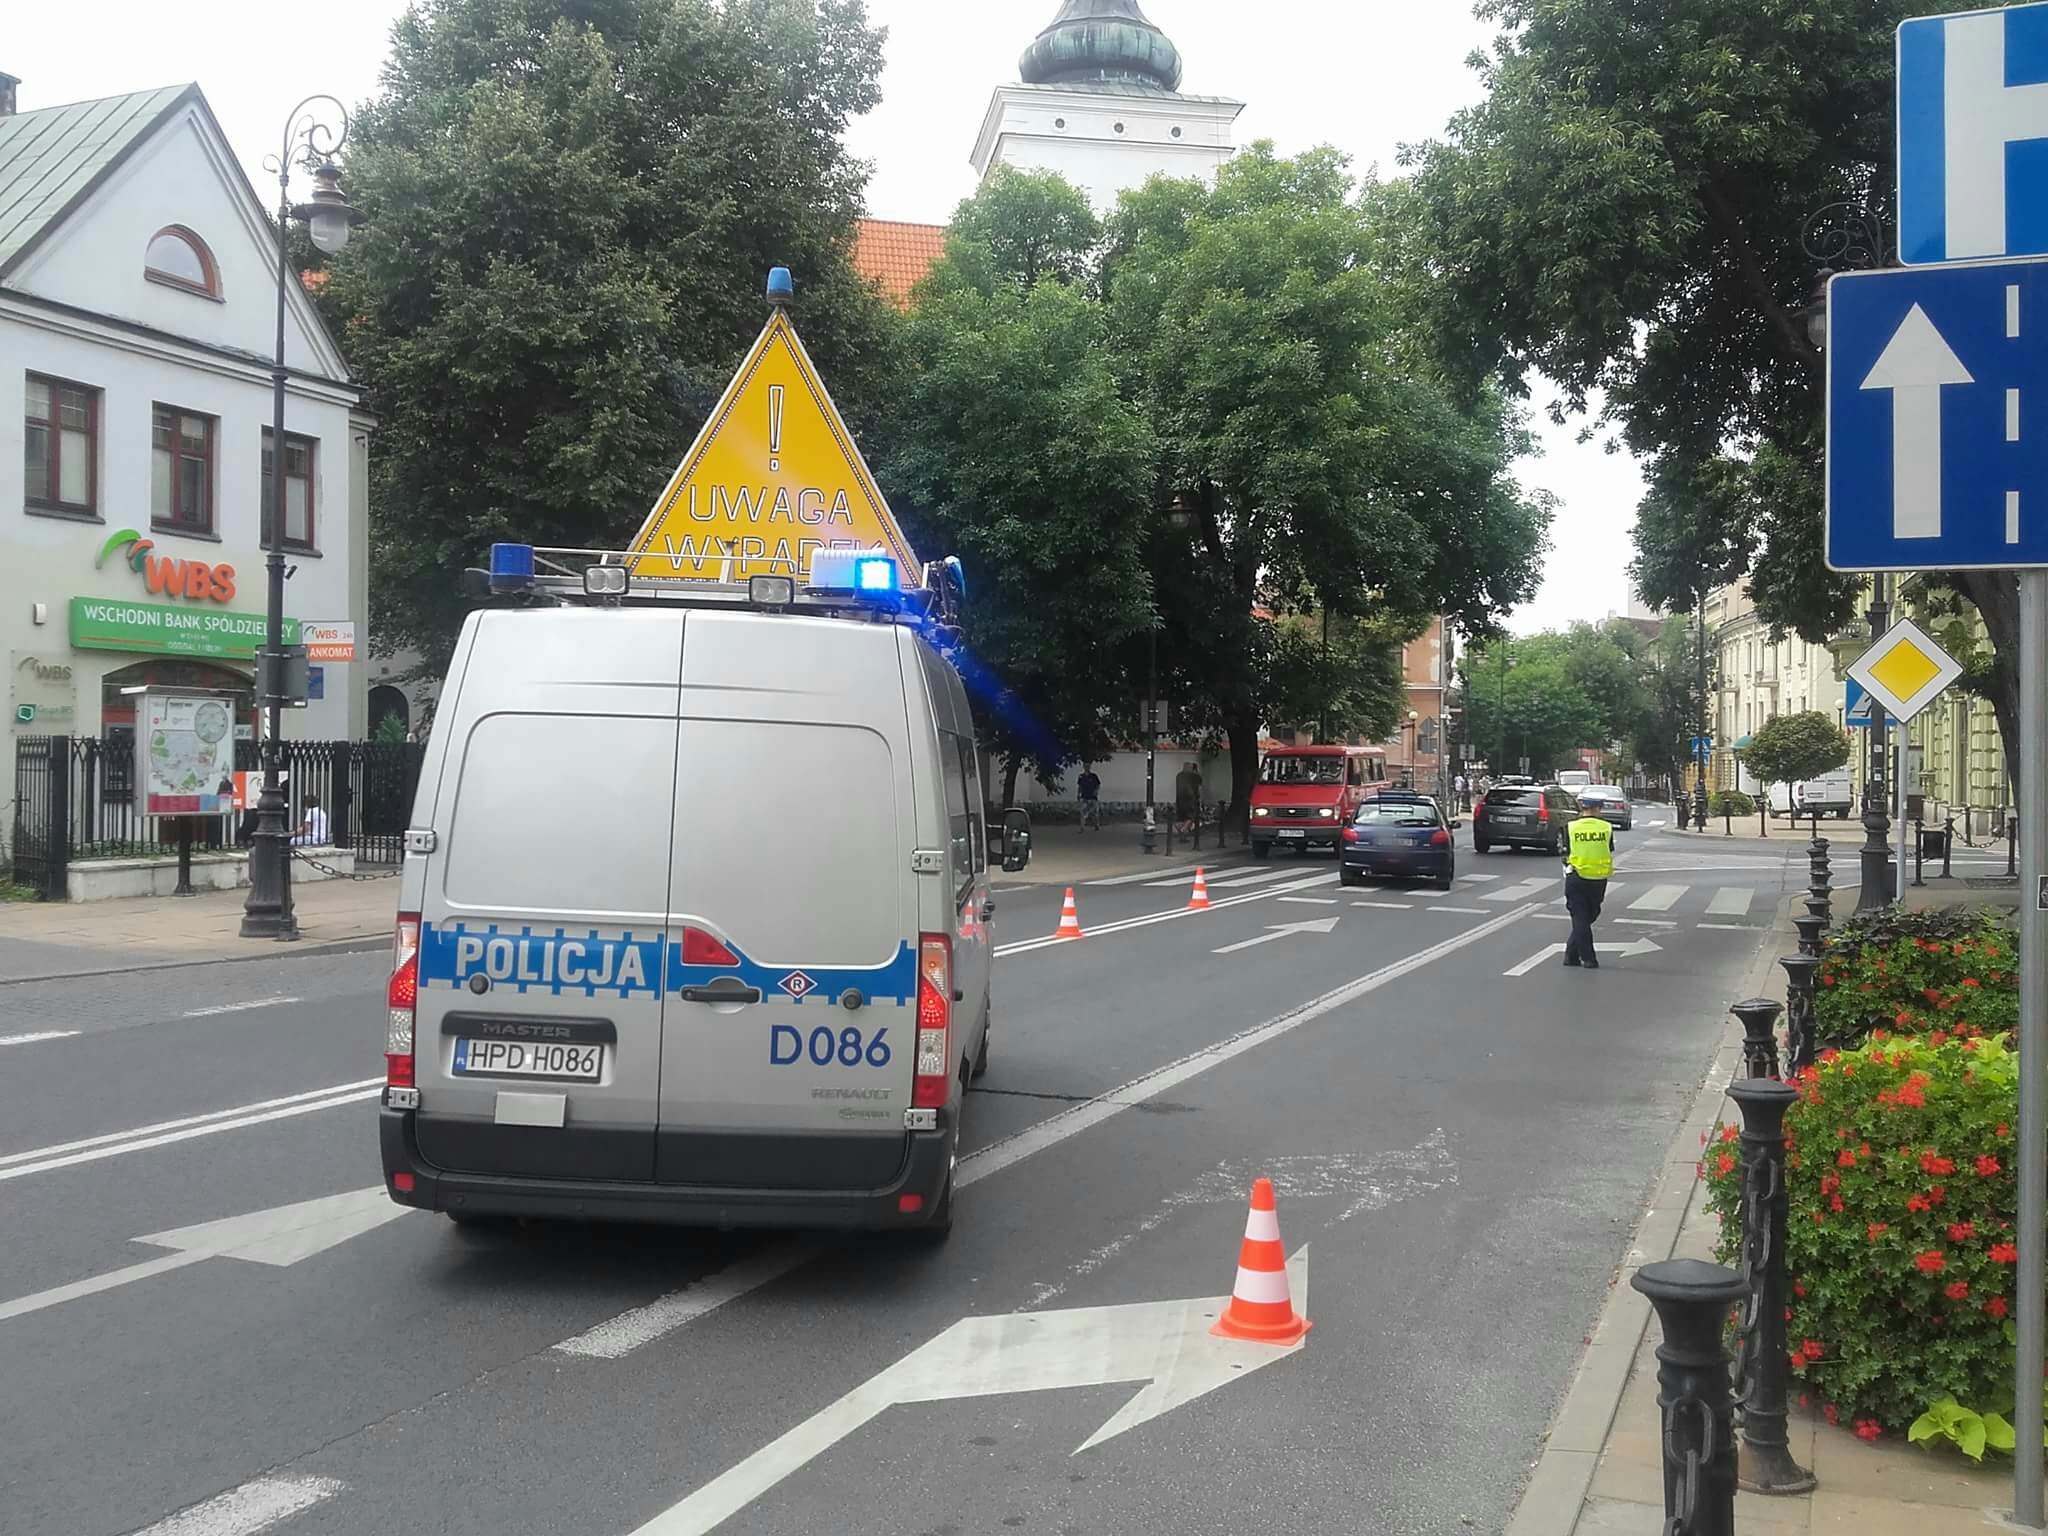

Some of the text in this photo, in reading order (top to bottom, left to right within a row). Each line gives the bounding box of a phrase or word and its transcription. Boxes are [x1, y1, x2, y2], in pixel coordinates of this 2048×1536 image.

[689, 485, 853, 525] UWAGA
[665, 534, 882, 576] WYPAD
[145, 555, 236, 604] WBS
[84, 605, 161, 626] WSCHODNI
[165, 612, 201, 630] BANK
[314, 629, 338, 639] WBS
[309, 647, 353, 657] ANKOMAT
[37, 665, 72, 680] WBS
[1575, 832, 1606, 843] POLICJA
[456, 936, 646, 986] POLICJA
[793, 979, 802, 989] R
[482, 1023, 571, 1038] MASTER
[770, 1024, 891, 1067] D086
[471, 1042, 524, 1070] HPD
[533, 1045, 595, 1073] H086
[811, 1088, 892, 1100] RENAULT
